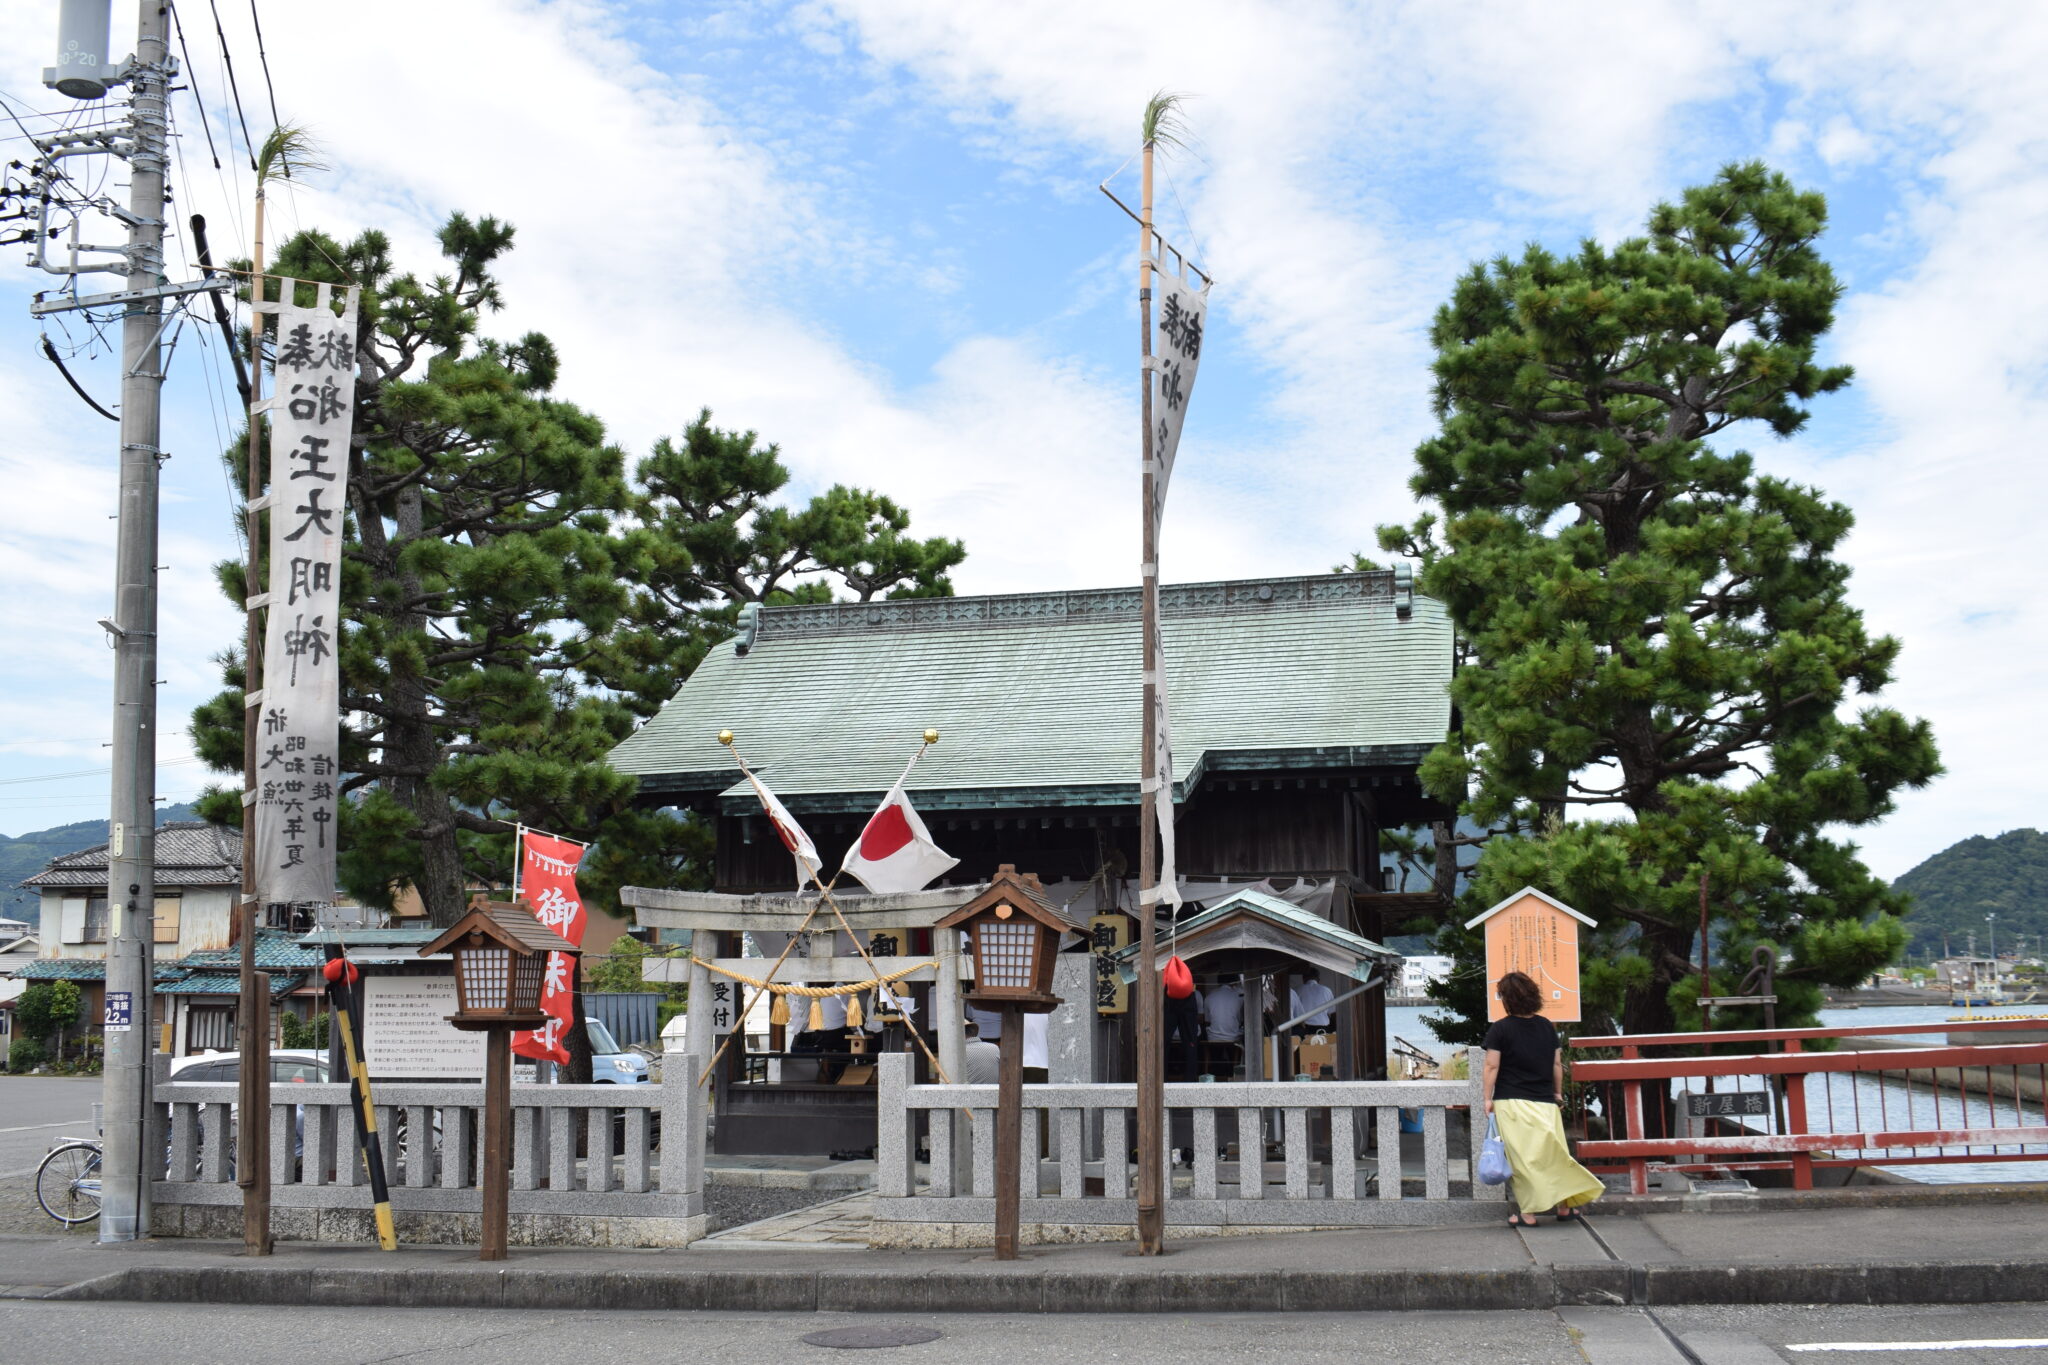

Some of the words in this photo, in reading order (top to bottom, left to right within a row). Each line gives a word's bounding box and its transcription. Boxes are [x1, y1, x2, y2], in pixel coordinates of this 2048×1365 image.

[112, 1001, 128, 1010] 海抜
[712, 983, 732, 1027] 受付
[1694, 1095, 1763, 1115] 新屋橋
